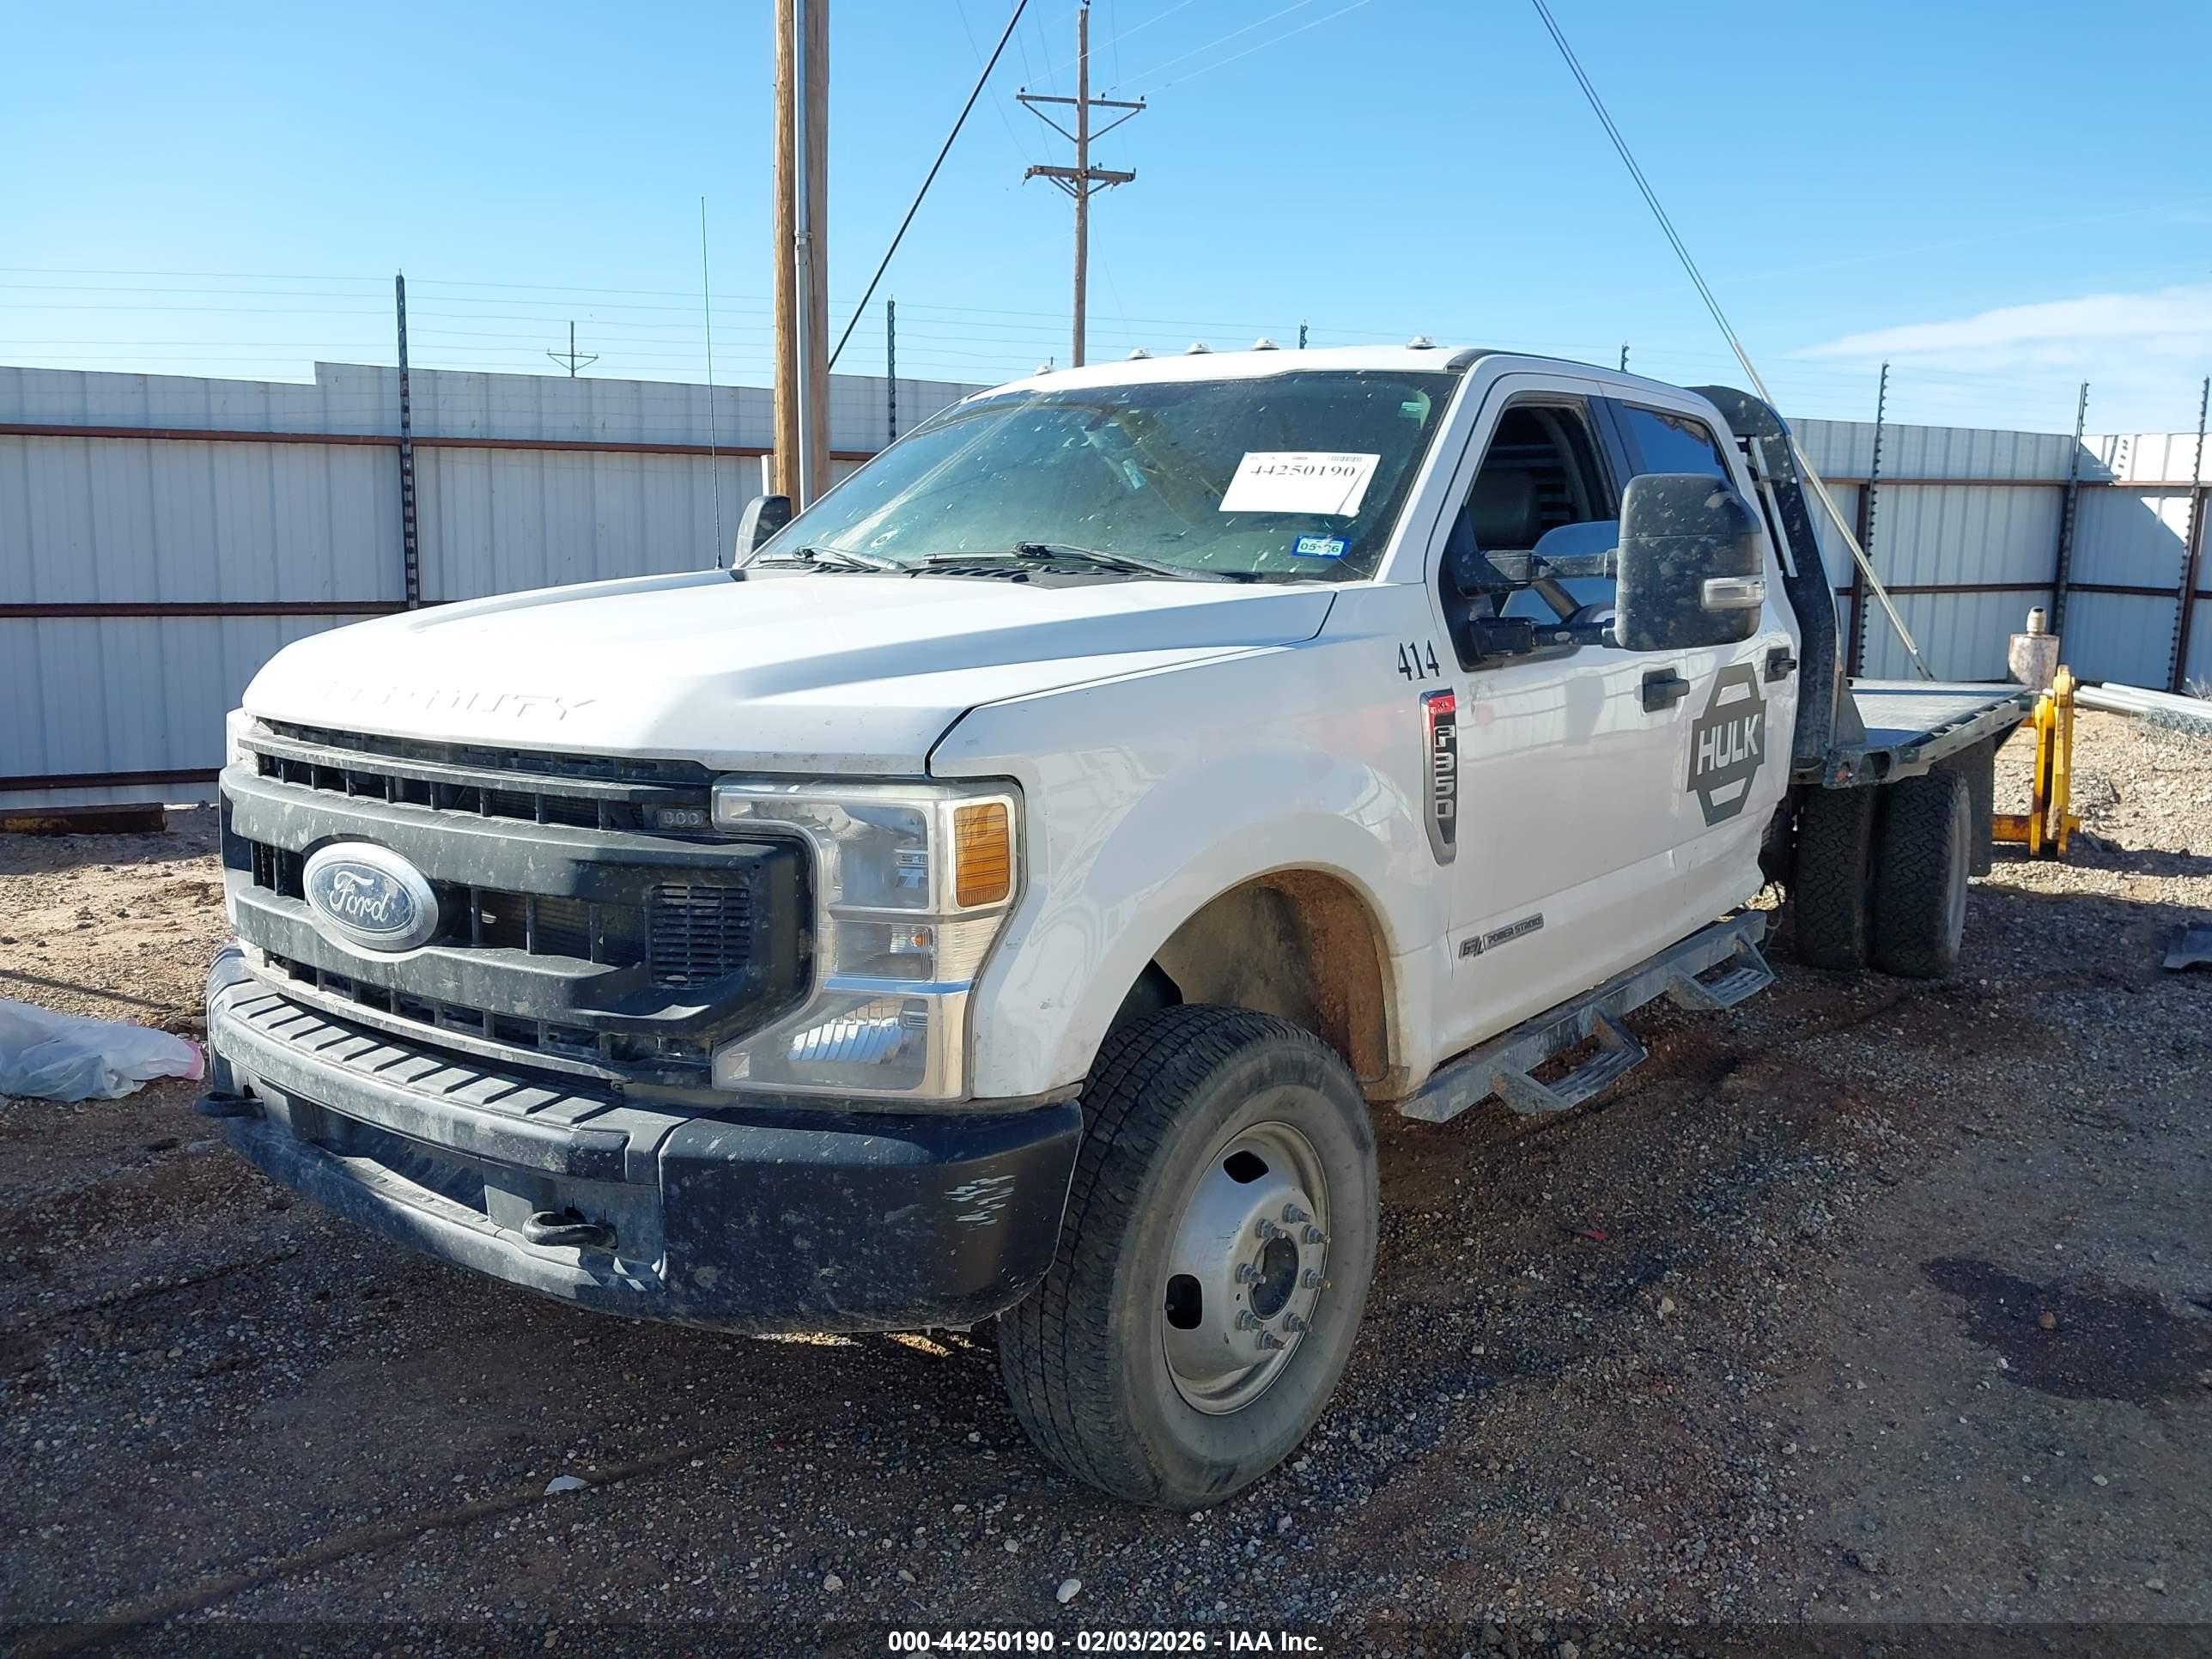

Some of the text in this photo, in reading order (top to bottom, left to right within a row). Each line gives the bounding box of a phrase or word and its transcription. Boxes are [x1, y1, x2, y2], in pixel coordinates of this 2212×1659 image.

[1250, 465, 1355, 477] 44250190
[1300, 543, 1317, 551] 05
[1397, 640, 1441, 681] 414
[1696, 713, 1760, 776] HULK
[329, 871, 390, 922] Ford
